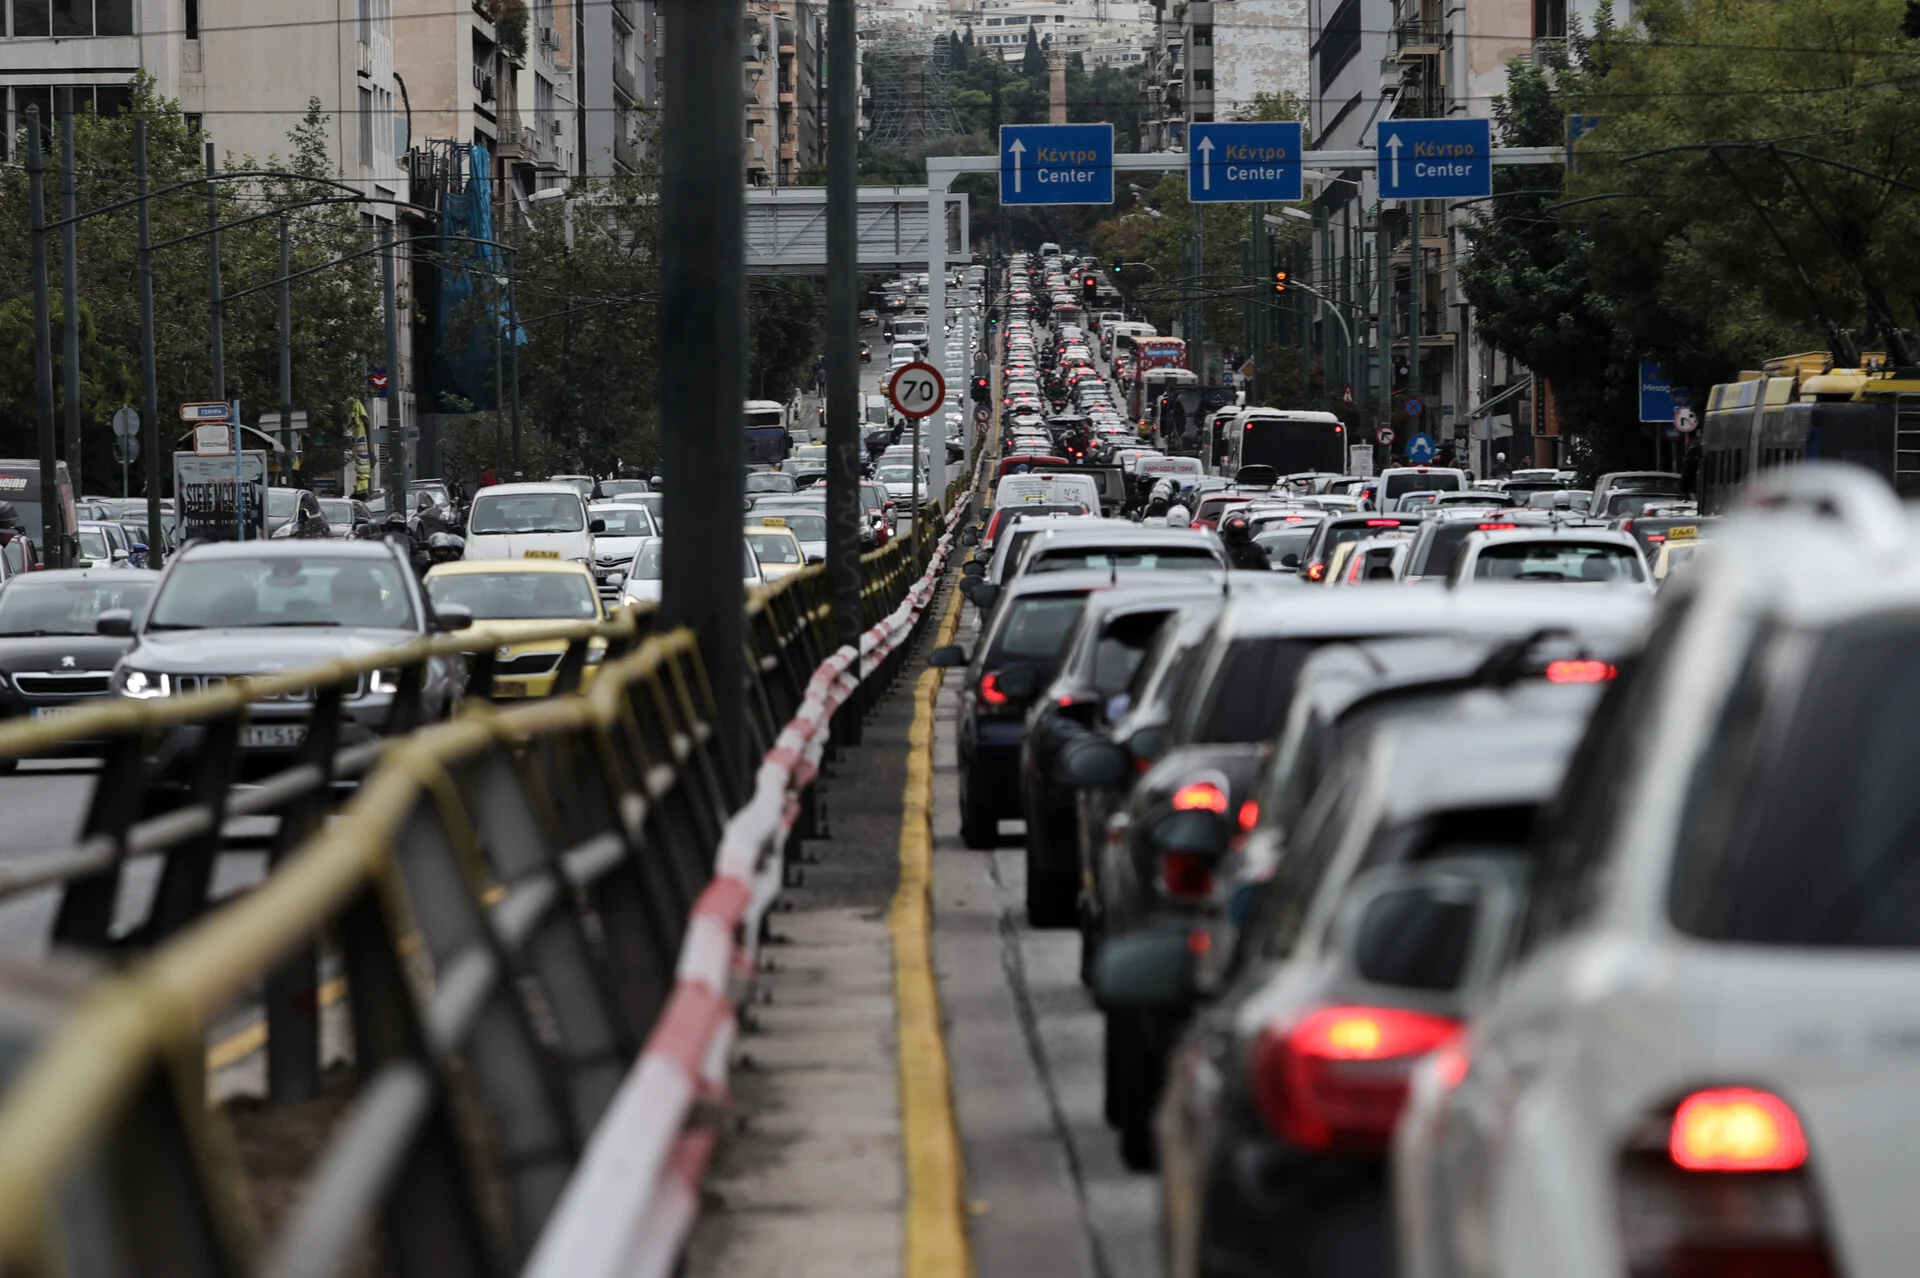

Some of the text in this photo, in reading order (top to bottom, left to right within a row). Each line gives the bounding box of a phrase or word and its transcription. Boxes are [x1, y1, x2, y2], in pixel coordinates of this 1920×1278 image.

[1037, 147, 1097, 164] Κέντρο
[1226, 144, 1287, 163] Κέντρο
[1414, 141, 1474, 158] Κέντρο
[1037, 168, 1095, 183] Center
[1226, 165, 1284, 181] Center
[1415, 162, 1473, 177] Center
[903, 380, 934, 401] 70
[1643, 384, 1674, 394] Mesog
